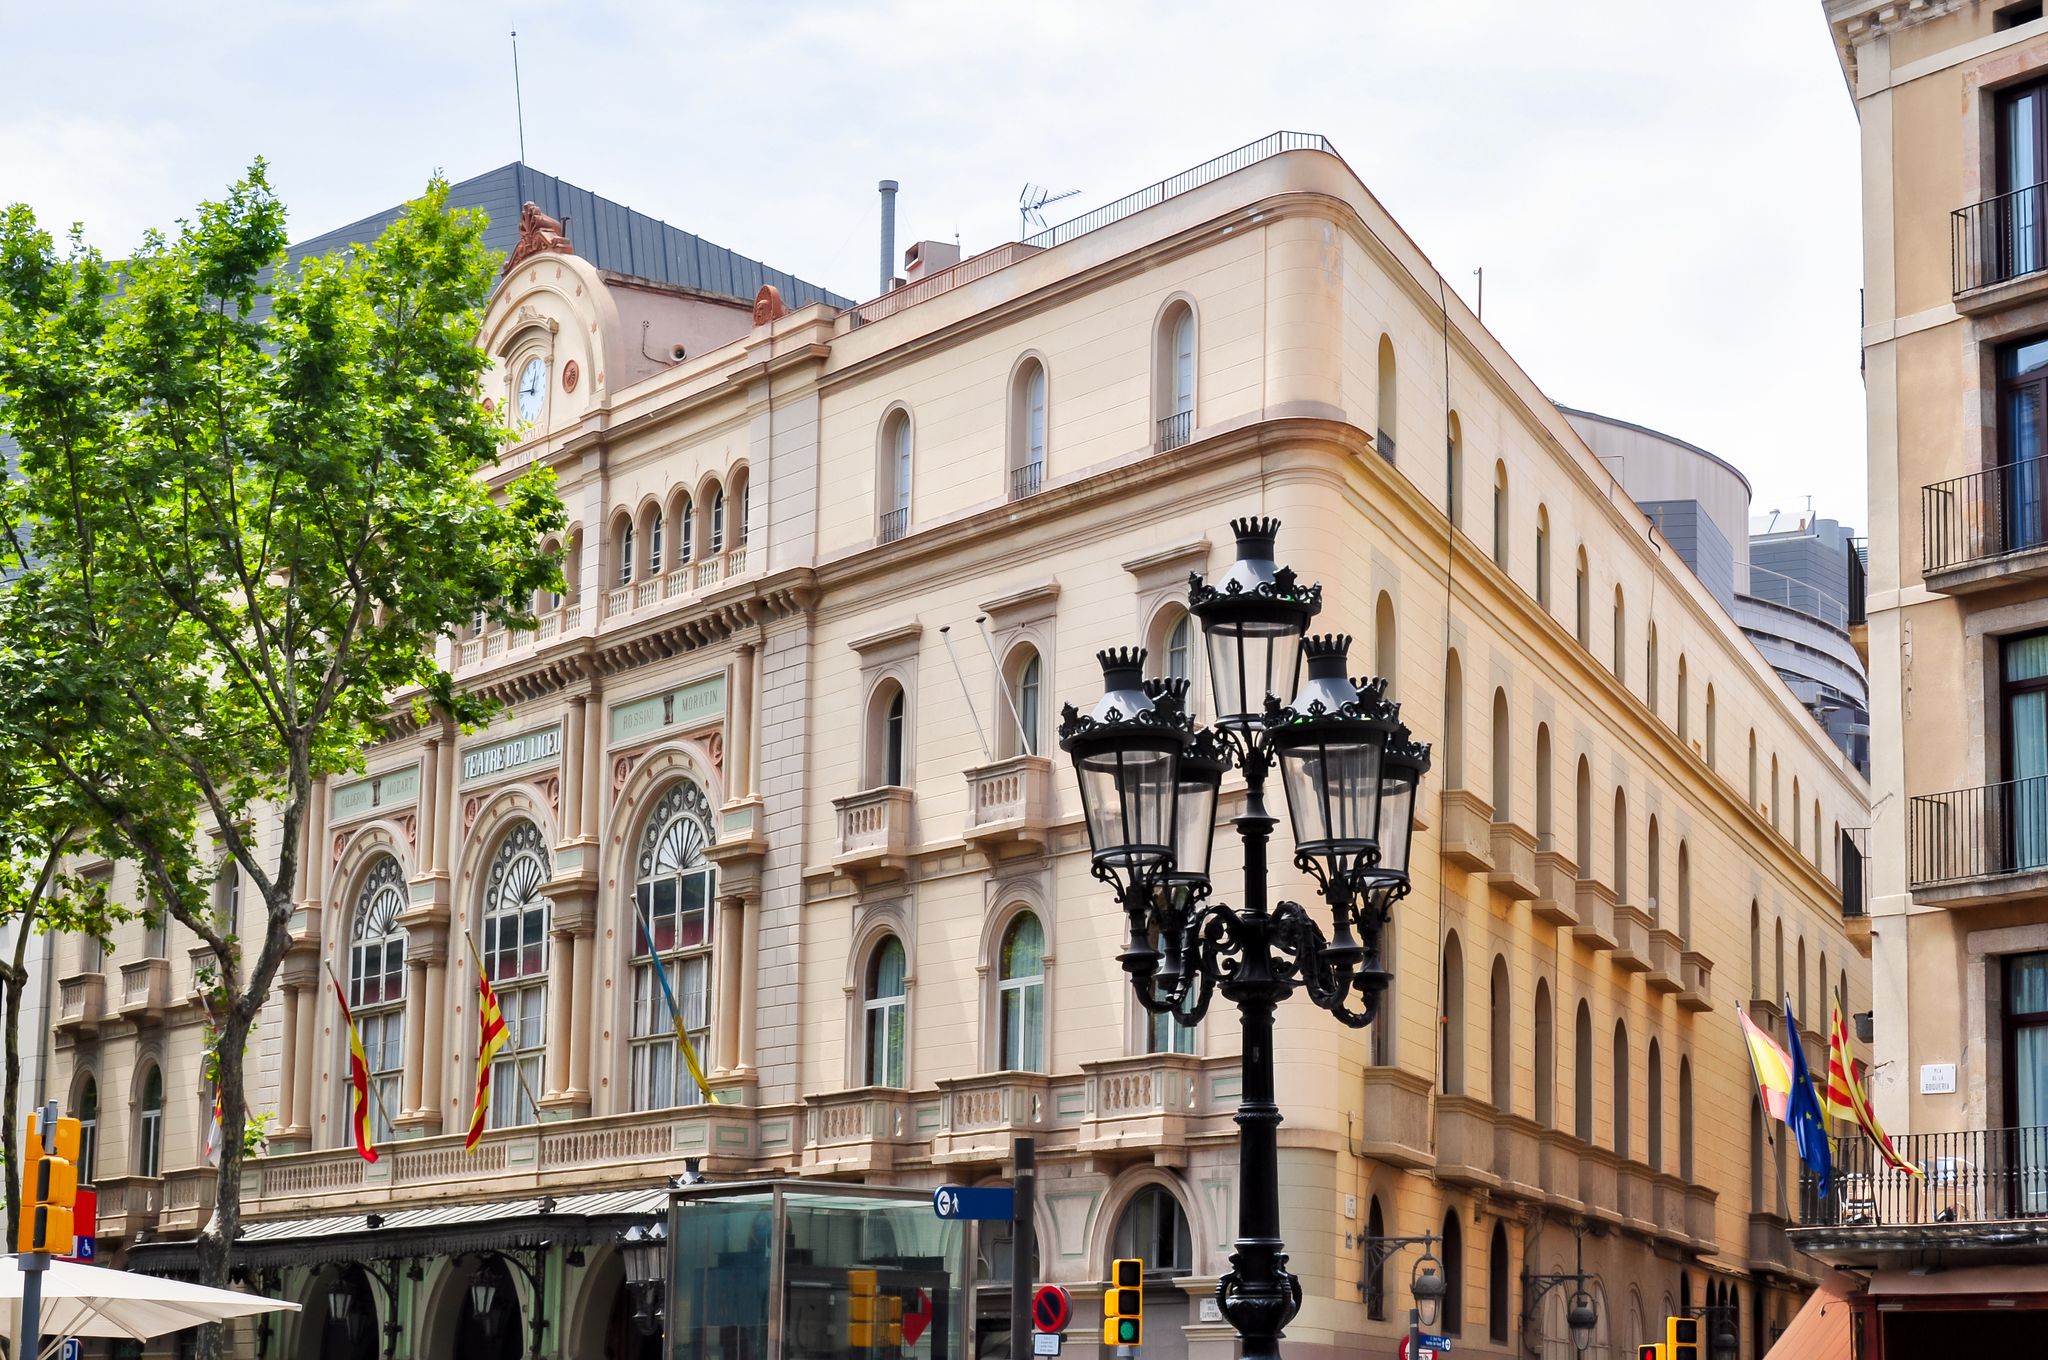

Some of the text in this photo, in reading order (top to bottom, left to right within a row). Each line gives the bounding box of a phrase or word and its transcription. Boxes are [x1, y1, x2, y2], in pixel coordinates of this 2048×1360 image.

[623, 707, 654, 730] ROSSINI
[464, 730, 561, 779] TEATRE DEL LICEU
[386, 777, 414, 797] MOZART
[63, 1343, 73, 1360] P
